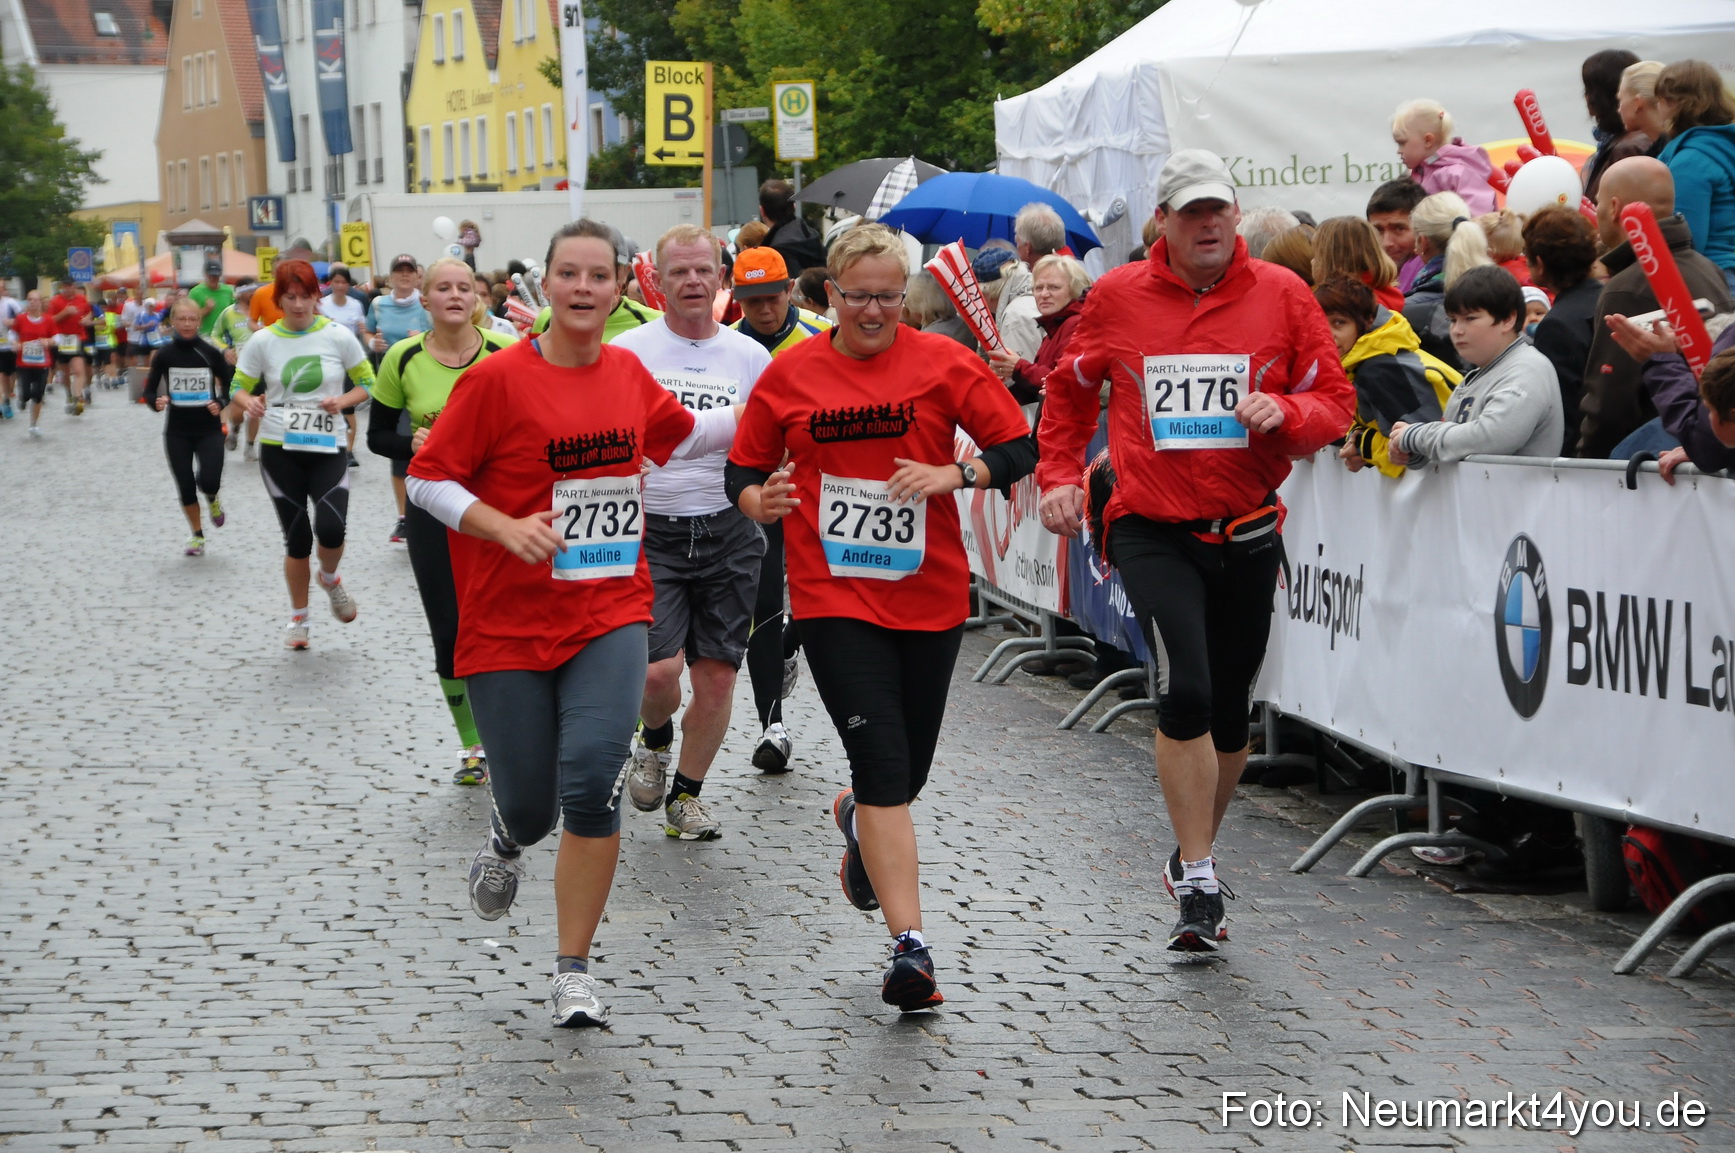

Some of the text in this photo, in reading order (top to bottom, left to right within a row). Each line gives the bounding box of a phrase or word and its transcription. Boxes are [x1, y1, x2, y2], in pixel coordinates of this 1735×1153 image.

[654, 66, 704, 84] Block
[664, 93, 695, 141] B
[1221, 154, 1333, 187] Kinder
[342, 224, 368, 233] Block
[349, 235, 363, 257] C
[71, 271, 90, 279] TAXI
[1147, 363, 1230, 375] PARTL Neumarkt
[173, 377, 206, 391] 2125
[656, 378, 725, 392] PARTL Neumarkt
[666, 389, 730, 411] 56
[1155, 377, 1239, 413] 2176
[289, 412, 334, 432] 2746
[815, 419, 903, 439] RUN FOR BÜRNI
[1169, 421, 1222, 435] Michael
[554, 444, 630, 469] RUN FOR BÜRNI
[556, 487, 634, 499] PARTL Neumarkt
[823, 483, 857, 497] PARTL
[564, 500, 639, 540] 2732
[827, 500, 915, 544] 2733
[579, 548, 621, 564] Nadine
[841, 549, 891, 566] Andrea
[1567, 587, 1673, 700] BMW
